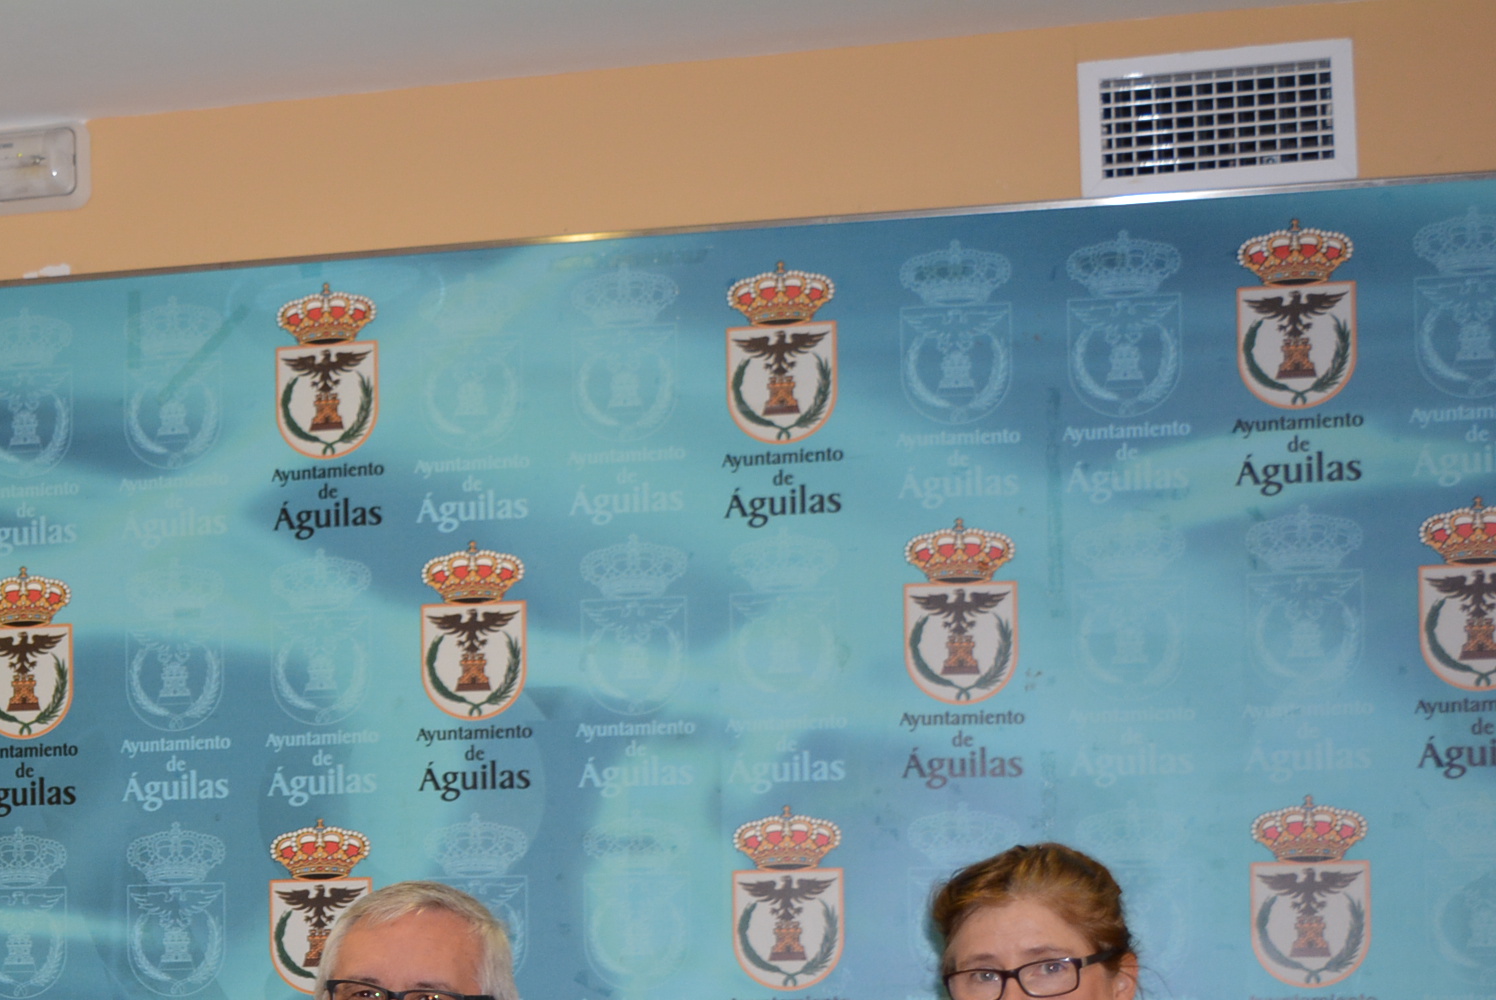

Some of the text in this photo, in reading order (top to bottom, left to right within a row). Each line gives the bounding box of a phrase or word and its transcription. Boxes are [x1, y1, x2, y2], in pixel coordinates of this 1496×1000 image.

[1062, 420, 1192, 444] Ayuntamiento
[1230, 412, 1365, 439] Ayuntamiento
[1465, 424, 1489, 443] de
[895, 427, 1022, 451] Ayuntamiento
[1286, 434, 1311, 454] de
[721, 446, 845, 473] Ayuntamiento
[1115, 442, 1139, 461] de
[271, 461, 386, 488] Ayuntamiento
[414, 454, 531, 480] Ayuntamiento
[772, 469, 796, 488] de
[1235, 450, 1365, 498] Águilas
[317, 483, 339, 501] de
[461, 474, 483, 492] de
[898, 465, 1021, 510] Águilas
[1066, 457, 1191, 504] Águilas
[16, 502, 36, 519] de
[416, 489, 530, 534] Águilas
[723, 484, 843, 529] Águilas
[272, 498, 384, 542] Águilas
[575, 718, 696, 743] Ayuntamiento
[899, 709, 1026, 733] Ayuntamiento
[1471, 716, 1495, 736] de
[120, 734, 232, 759] Ayuntamiento
[265, 728, 381, 751] Ayuntamiento
[416, 723, 533, 747] Ayuntamiento
[951, 730, 974, 749] de
[312, 749, 334, 767] de
[464, 743, 485, 761] de
[625, 739, 647, 757] de
[14, 761, 36, 778] de
[165, 755, 187, 772] de
[727, 750, 846, 795] Águilas
[901, 746, 1025, 791] Águilas
[266, 764, 378, 808] Águilas
[417, 758, 532, 804] Águilas
[578, 755, 694, 799] Águilas
[121, 768, 231, 812] Águilas
